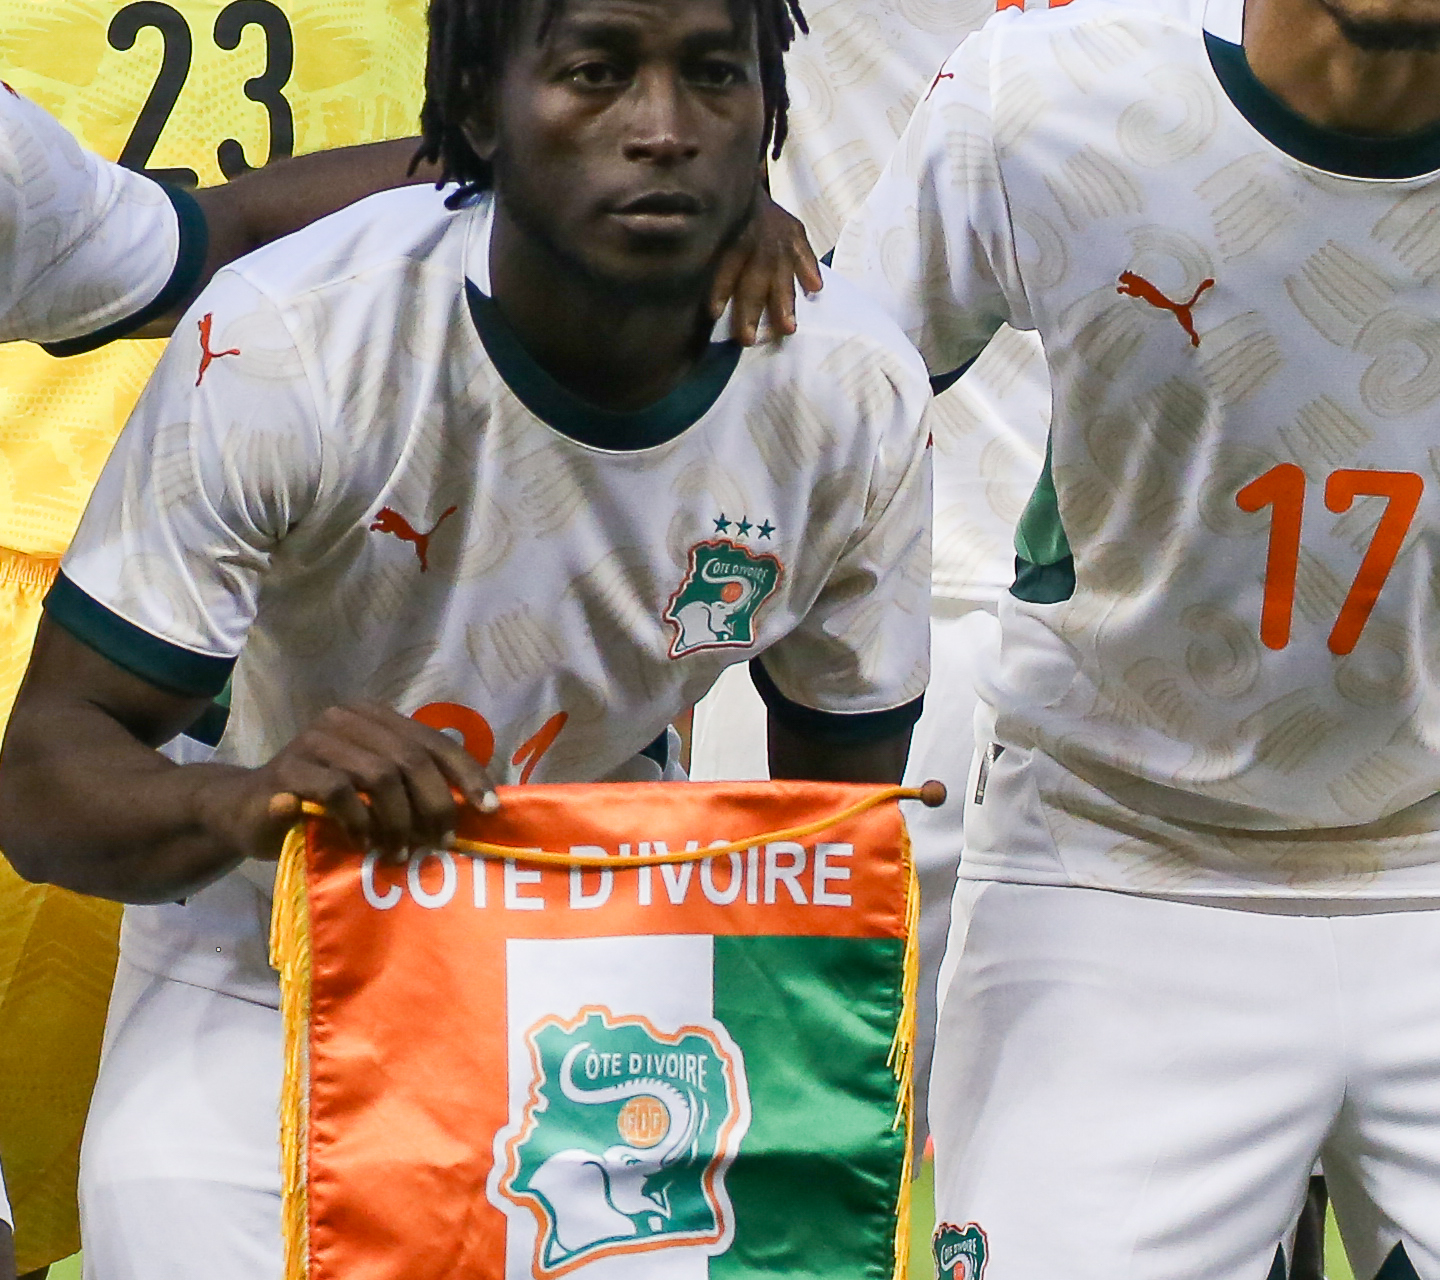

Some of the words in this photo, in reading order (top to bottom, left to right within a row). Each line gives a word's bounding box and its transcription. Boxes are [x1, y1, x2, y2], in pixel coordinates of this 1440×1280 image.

[1235, 462, 1425, 656] 17
[569, 840, 855, 908] D'IVOIRE
[627, 1051, 709, 1094] D'IVOIRE
